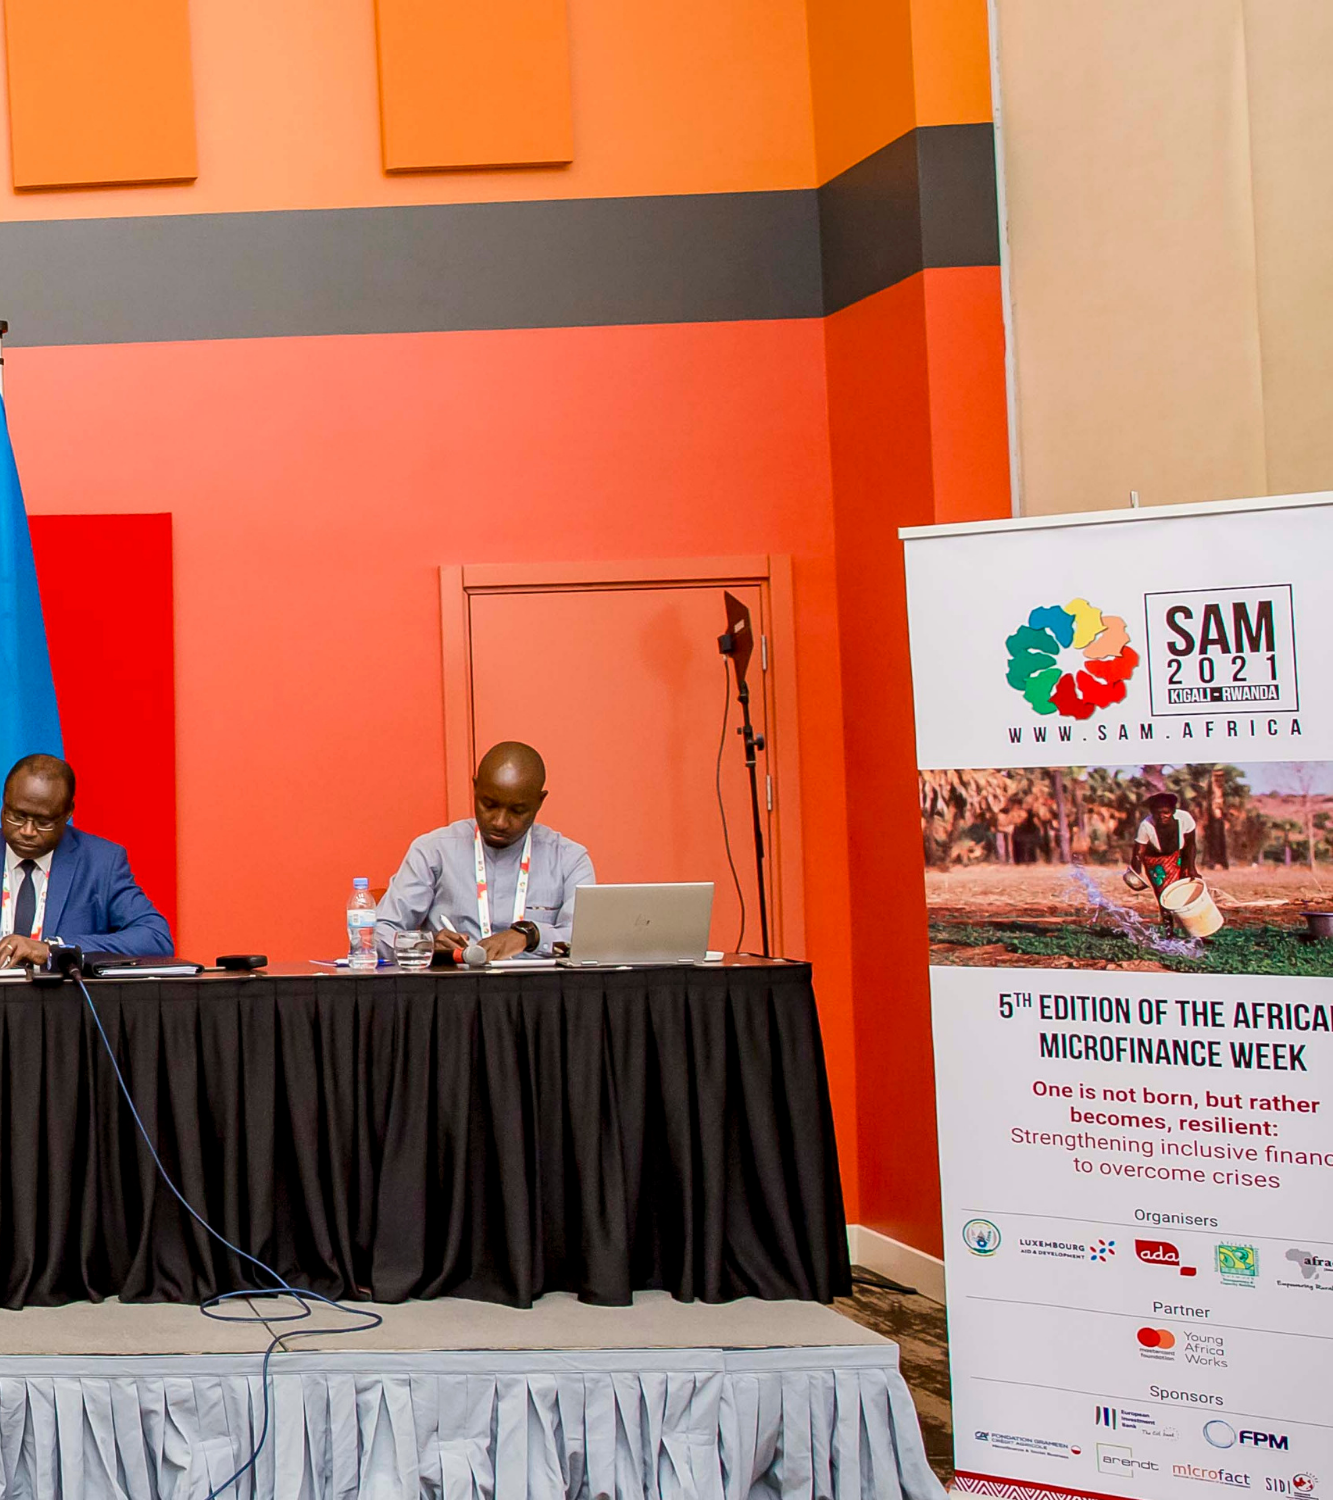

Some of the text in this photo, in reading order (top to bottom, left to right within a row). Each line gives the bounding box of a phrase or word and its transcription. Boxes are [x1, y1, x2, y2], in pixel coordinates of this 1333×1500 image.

[1166, 600, 1275, 657] SAM
[1167, 654, 1277, 685] 2021
[1170, 688, 1211, 703] KIGALI
[1222, 686, 1278, 701] RWANDA
[1009, 718, 1302, 744] WWW.SAM.AFRICA
[999, 992, 1333, 1032] 5TH EDITION OF THE AFRICA
[1040, 1032, 1308, 1072] MICROFINANCE WEEK
[1032, 1080, 1320, 1113] One is not born, but rather
[1070, 1106, 1279, 1137] becomes, resilient:
[1011, 1127, 1154, 1158] Strengthening
[1161, 1138, 1258, 1161] inclusive
[1073, 1157, 1281, 1188] to overcome crises
[1134, 1208, 1219, 1228] Organisers
[1020, 1238, 1085, 1252] LUXEMBOURG
[1140, 1246, 1179, 1262] ada
[1304, 1256, 1333, 1267] afra
[1153, 1301, 1210, 1318] Partner
[1184, 1330, 1224, 1346] Young
[1185, 1343, 1224, 1356] Africa
[1185, 1353, 1228, 1368] Works
[1150, 1385, 1224, 1406] Sponsors
[1120, 1410, 1150, 1418] European
[1239, 1430, 1289, 1450] FPM
[1102, 1456, 1159, 1471] arendt
[1172, 1464, 1251, 1486] microfact
[1265, 1477, 1291, 1495] SIDI
